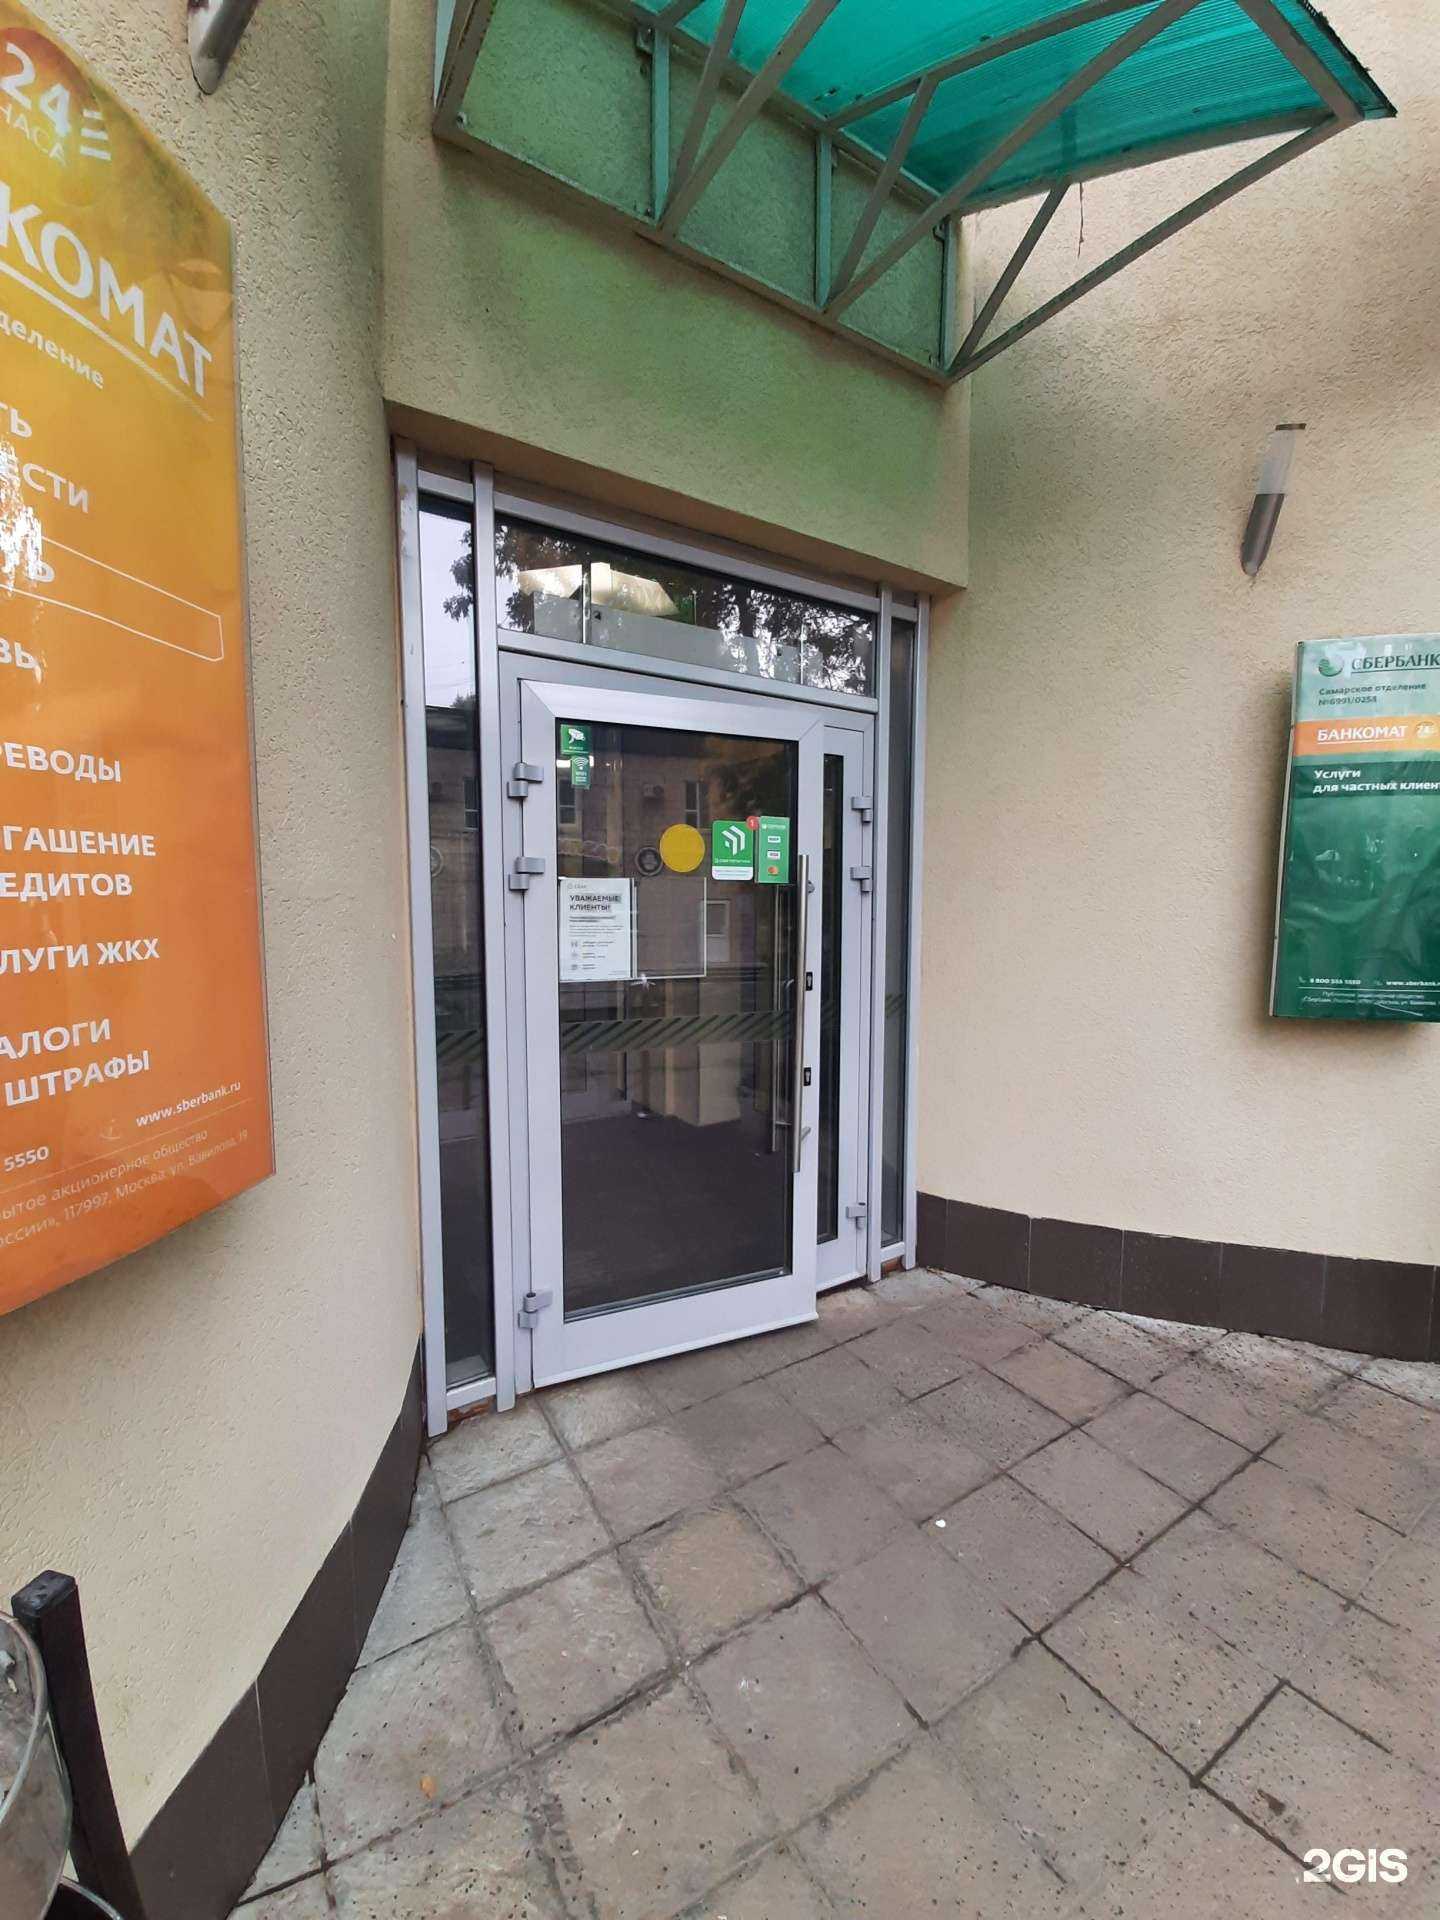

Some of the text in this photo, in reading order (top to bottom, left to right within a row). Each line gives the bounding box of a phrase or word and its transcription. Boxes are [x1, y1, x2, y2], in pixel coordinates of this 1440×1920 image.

[0, 42, 71, 138] 24
[0, 181, 213, 397] КОМАТ
[1352, 653, 1440, 670] СБЕРБАНК
[1319, 683, 1427, 696] Самарское отделение
[1317, 725, 1408, 742] БАНКОМАТ
[0, 742, 121, 783] ЕВОДЫ
[1314, 769, 1361, 780] Услуги
[1312, 783, 1338, 793] для
[1341, 782, 1397, 791] частных
[2, 825, 157, 857] ГАШЕНИЕ
[0, 938, 160, 975] ЛУГИ ЖКХ
[4, 1050, 150, 1106] ШТРАФЫ
[135, 1081, 241, 1127] www.sberbank.ru
[4, 1146, 49, 1172] 5550
[51, 1154, 150, 1201] акционерное
[152, 1130, 208, 1161] общество
